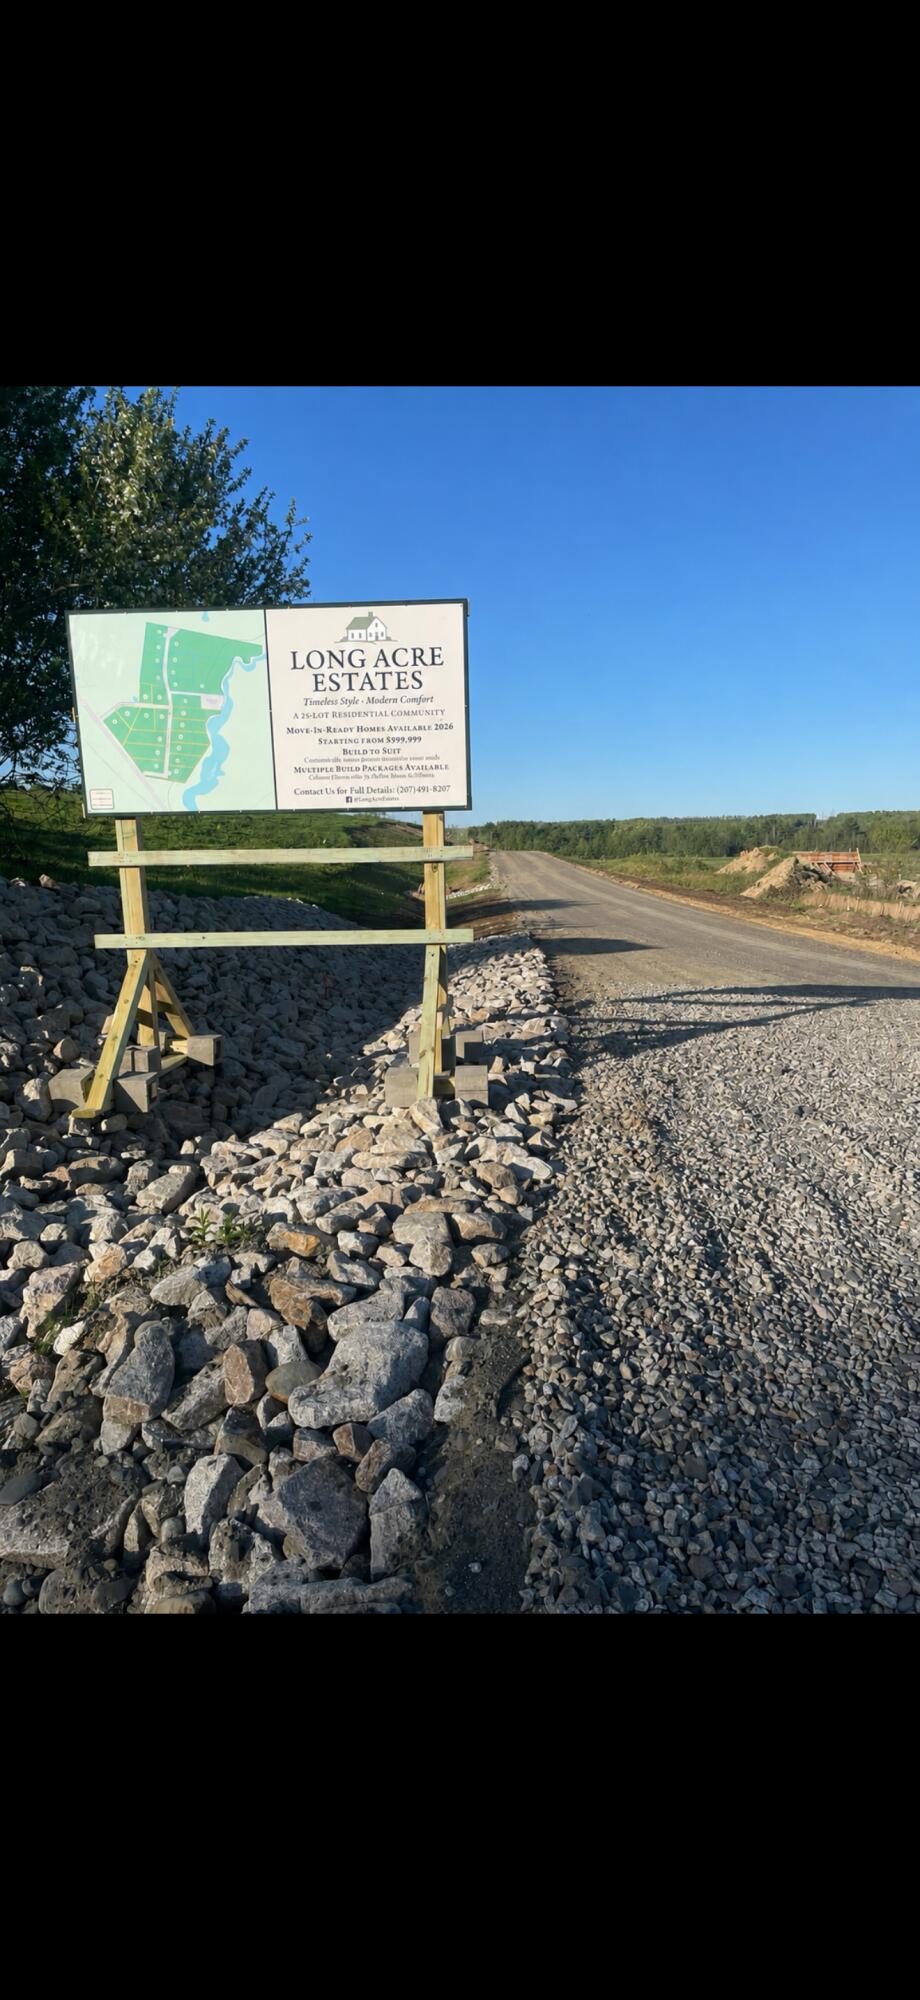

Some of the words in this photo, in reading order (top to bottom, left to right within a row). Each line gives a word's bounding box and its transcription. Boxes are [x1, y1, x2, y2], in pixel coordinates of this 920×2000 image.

[290, 648, 366, 670] LONG
[373, 646, 444, 668] ACRE
[312, 670, 423, 692] ESTATES
[303, 697, 338, 706] Timeless
[340, 697, 360, 708] Style
[366, 695, 398, 705] Modern
[399, 694, 434, 706] Comfort
[332, 710, 389, 718] RESIDENTIAL
[391, 709, 445, 717] COMMUNITY
[356, 725, 385, 733] HOMES
[387, 724, 432, 732] AVAILABLE
[434, 723, 454, 731] 2026
[386, 735, 422, 744] $999,999
[293, 766, 334, 774] MULTIPLE
[335, 765, 360, 773] BUILD
[362, 764, 403, 772] PACKAGES
[405, 763, 449, 771] AVAILABLE
[293, 787, 323, 795] Contact
[325, 787, 335, 795] Us
[336, 786, 347, 795] for
[350, 785, 365, 794] Full
[366, 785, 395, 794] Details:
